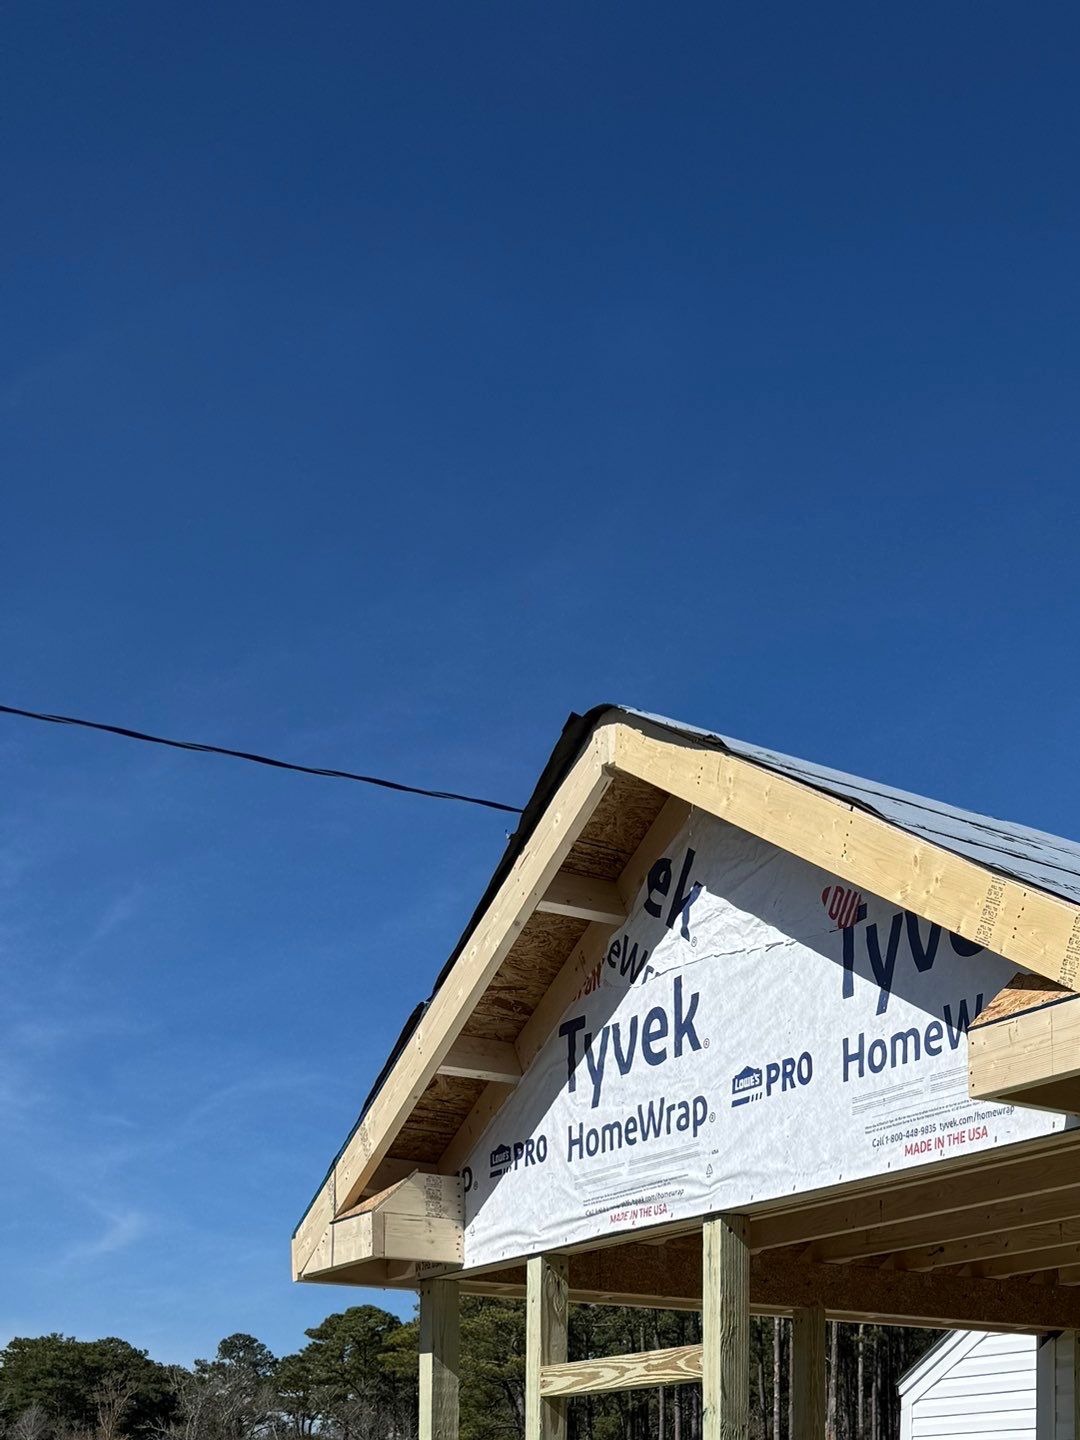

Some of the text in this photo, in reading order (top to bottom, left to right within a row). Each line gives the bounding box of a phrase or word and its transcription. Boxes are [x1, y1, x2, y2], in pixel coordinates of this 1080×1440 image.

[558, 974, 703, 1109] Tyvek
[766, 1051, 813, 1097] PRO
[567, 1095, 708, 1162] HomeWrap
[939, 1105, 1015, 1131] tyvek.com/homewrap
[513, 1134, 548, 1171] PRO
[904, 1125, 989, 1157] MADE IN THE USA
[609, 1210, 630, 1224] MADE
[639, 1205, 652, 1218] THE
[653, 1202, 668, 1216] USA
